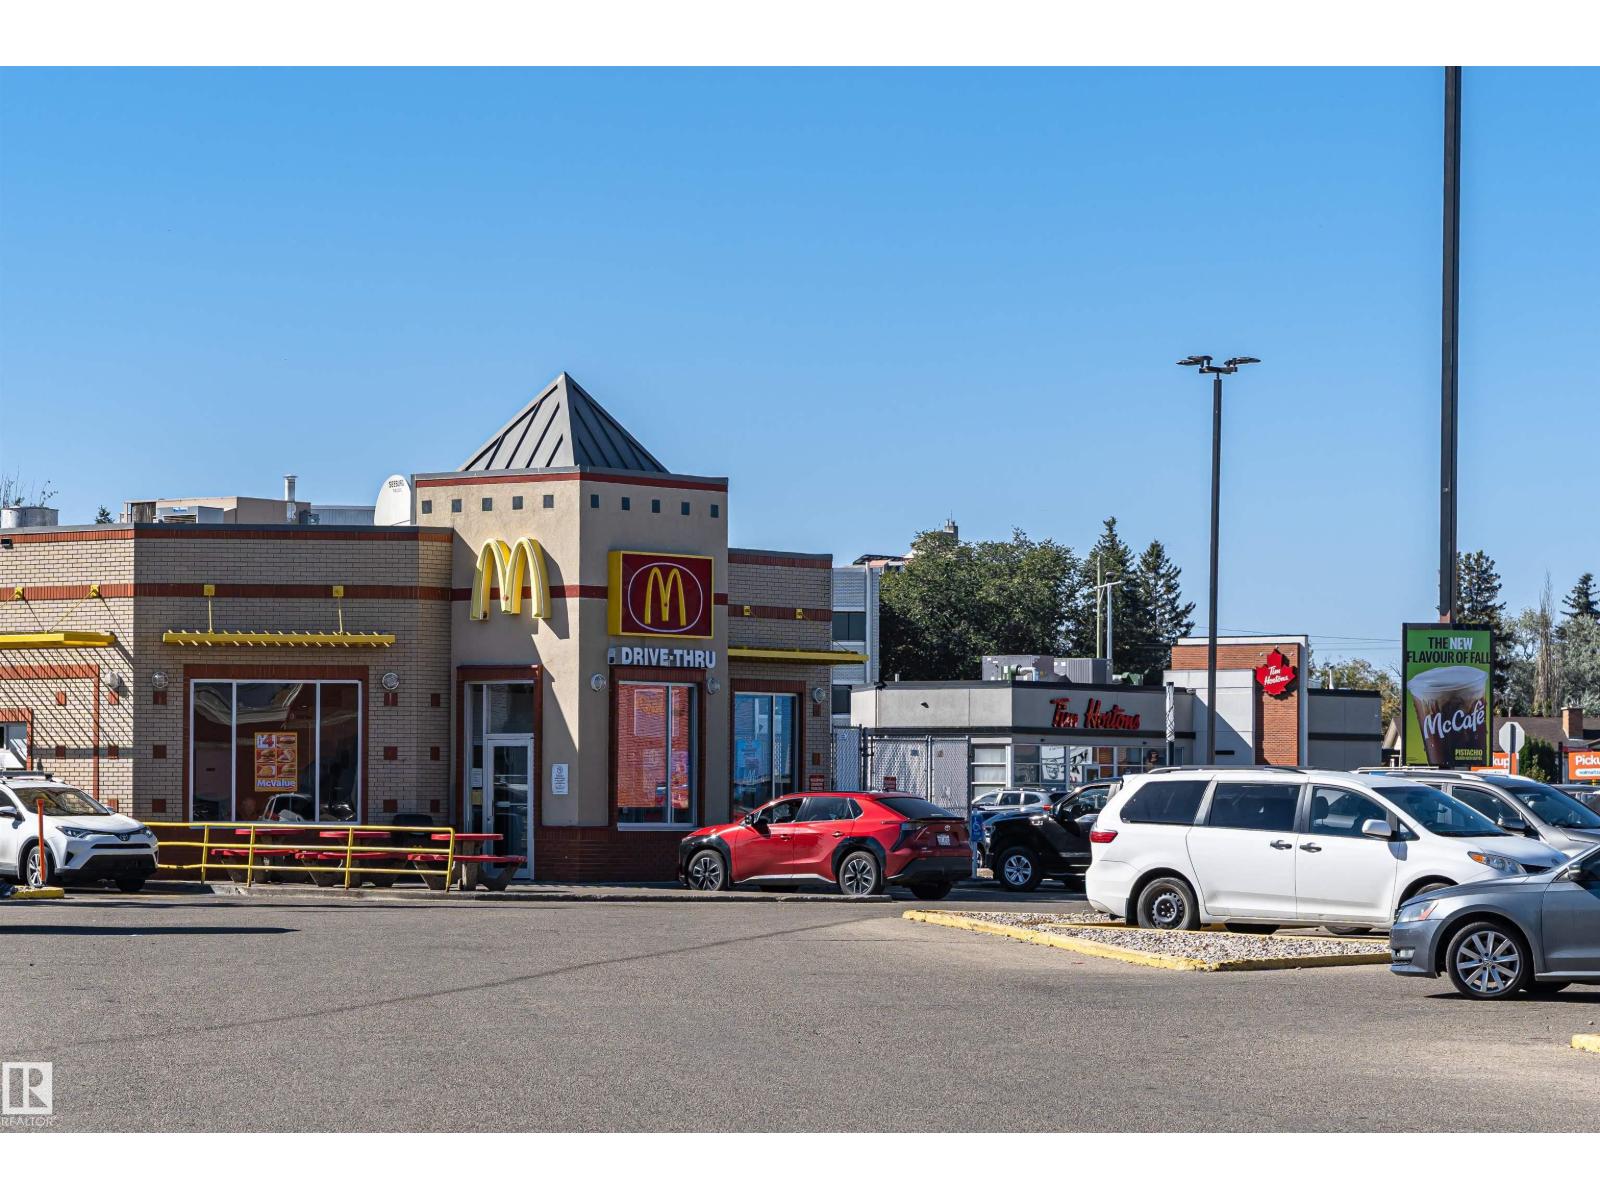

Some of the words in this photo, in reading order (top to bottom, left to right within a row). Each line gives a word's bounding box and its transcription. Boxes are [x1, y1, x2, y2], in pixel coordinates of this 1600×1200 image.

[1428, 637, 1449, 650] THE
[1449, 637, 1473, 651] NEW
[621, 646, 716, 669] DRIVE-THRU
[1407, 650, 1455, 664] FLAVOUR
[1456, 651, 1469, 664] OF
[1470, 652, 1491, 664] FALL
[1268, 665, 1281, 676] Tim
[1264, 675, 1289, 686] Hortons
[1049, 697, 1079, 728] Tim
[1083, 697, 1141, 730] Hortons
[1423, 700, 1485, 739] McCafé
[256, 779, 296, 788] McValue
